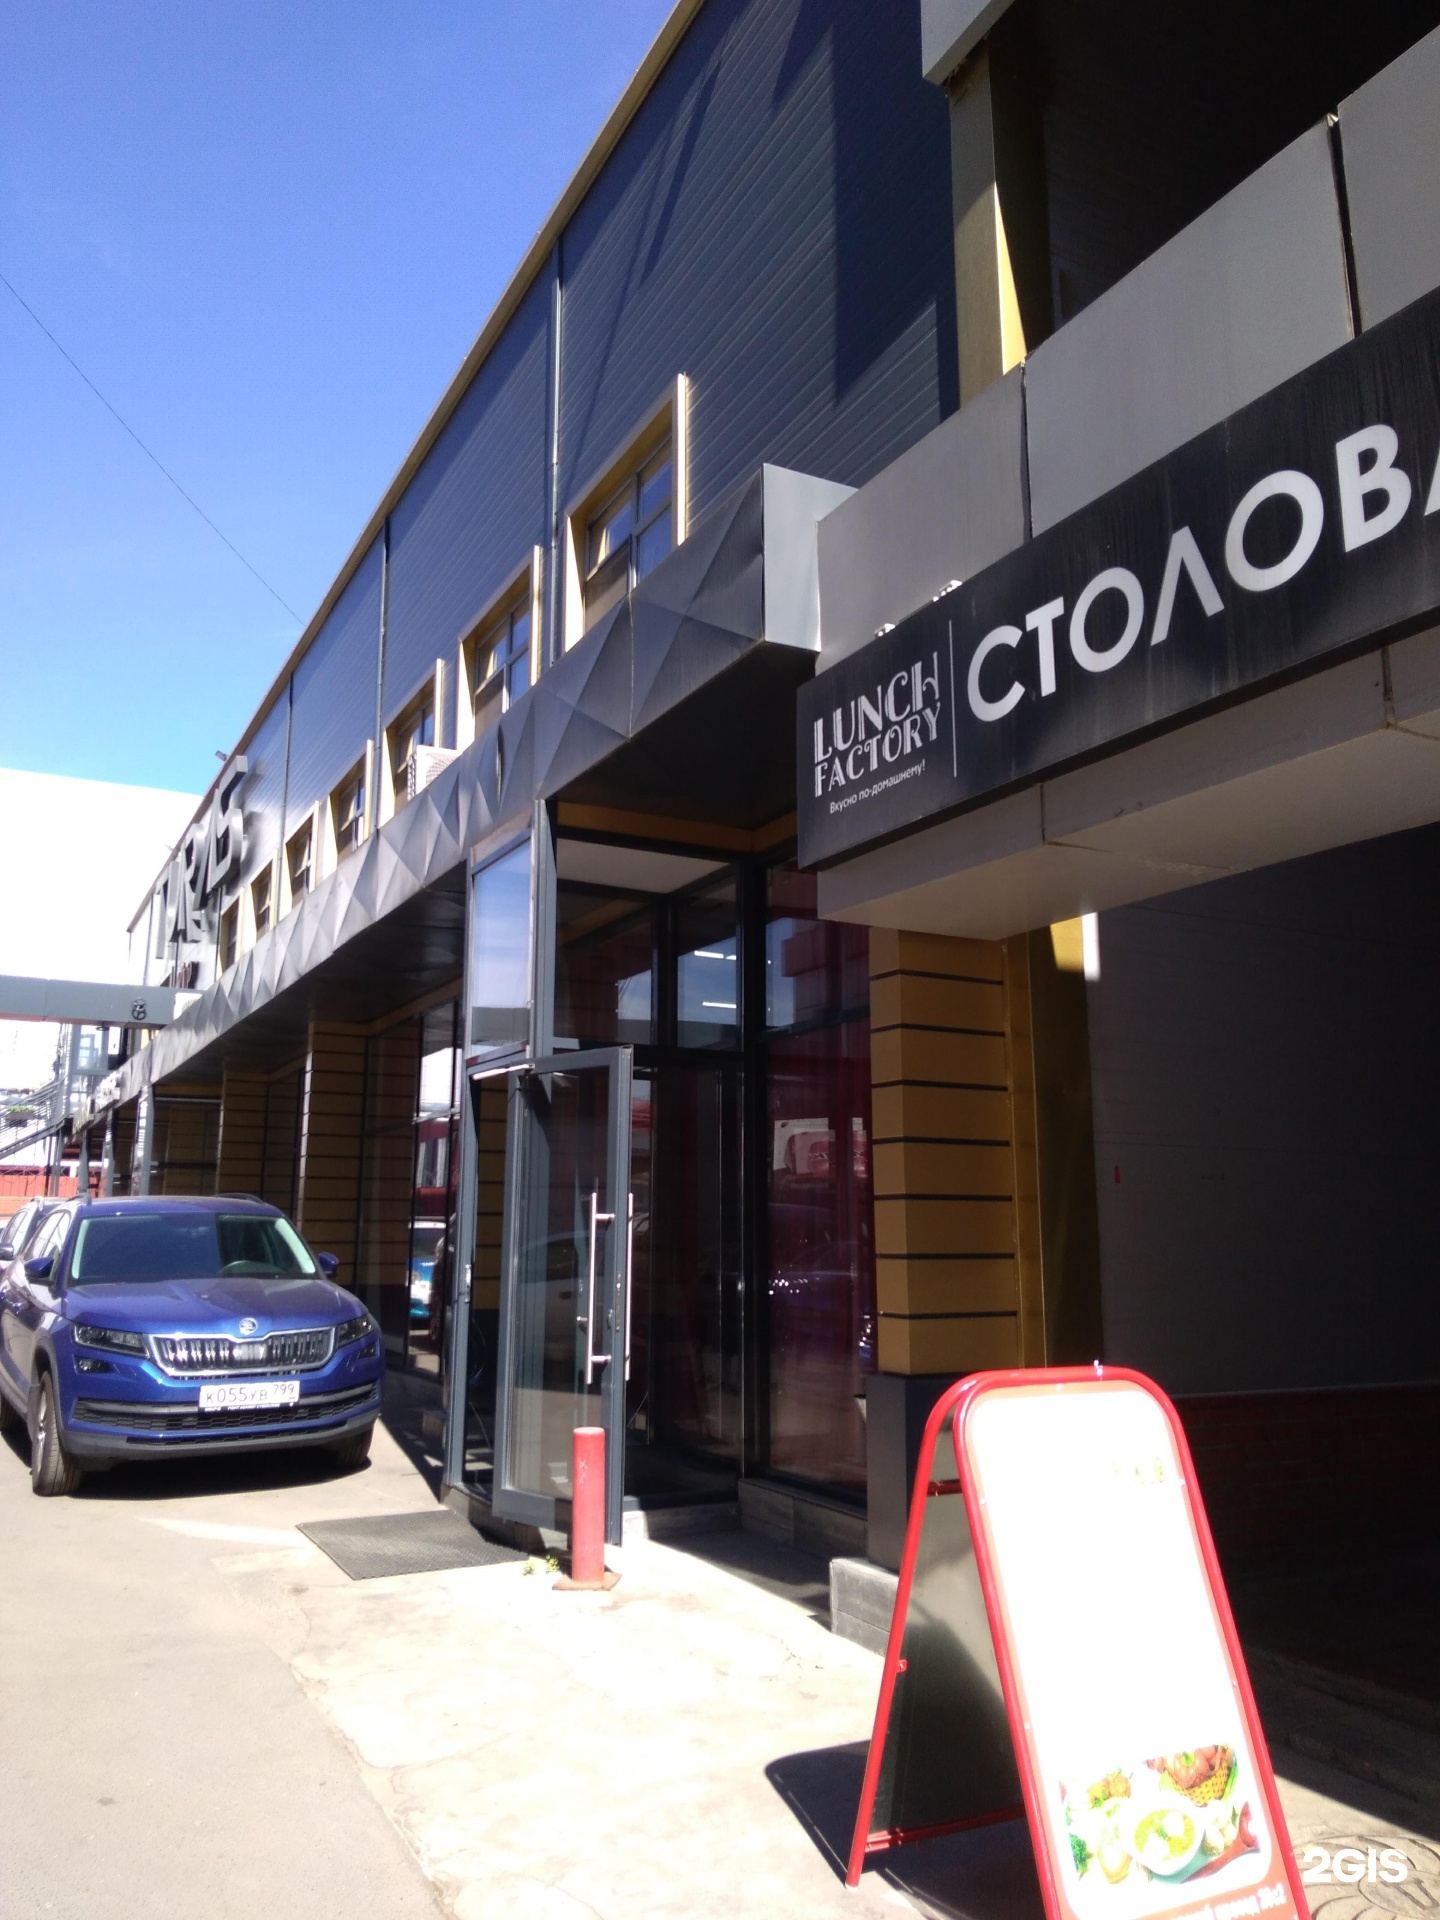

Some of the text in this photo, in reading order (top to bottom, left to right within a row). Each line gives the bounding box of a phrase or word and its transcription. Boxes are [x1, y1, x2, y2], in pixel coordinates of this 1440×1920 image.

[968, 423, 1440, 723] СТОЛОВ
[814, 651, 940, 764] LUNCH
[814, 701, 941, 798] FACTORY
[829, 758, 927, 815] Вкусно по-домашнему!
